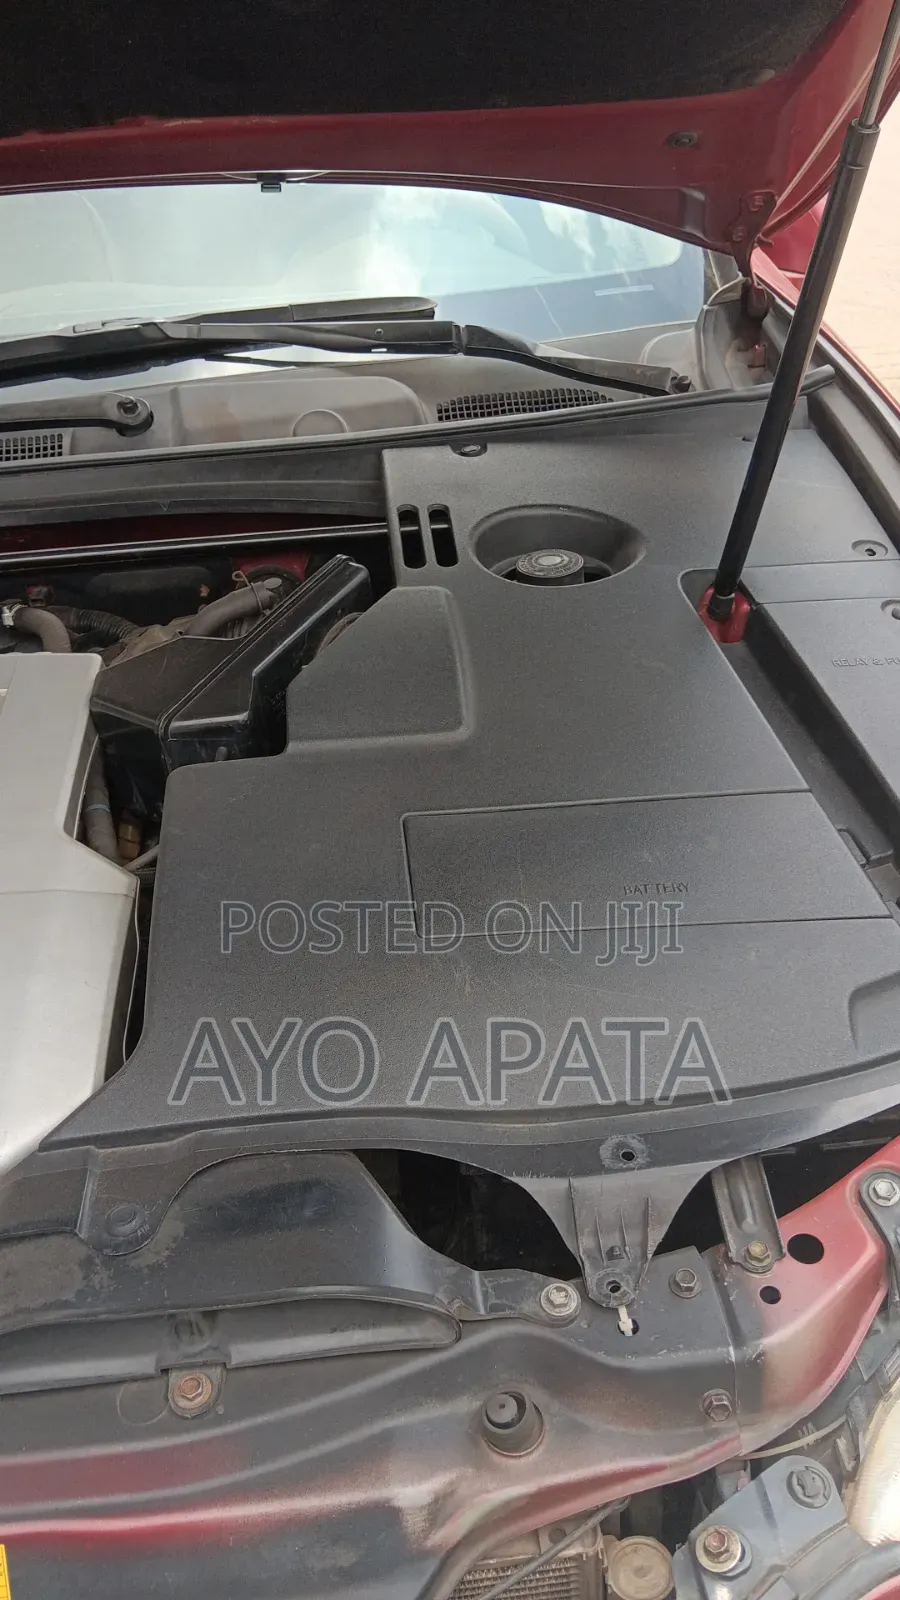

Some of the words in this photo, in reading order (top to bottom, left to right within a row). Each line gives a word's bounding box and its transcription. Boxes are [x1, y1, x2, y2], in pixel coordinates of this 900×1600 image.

[831, 658, 868, 667] RELAY
[872, 657, 884, 666] &
[623, 882, 689, 896] BATTERY
